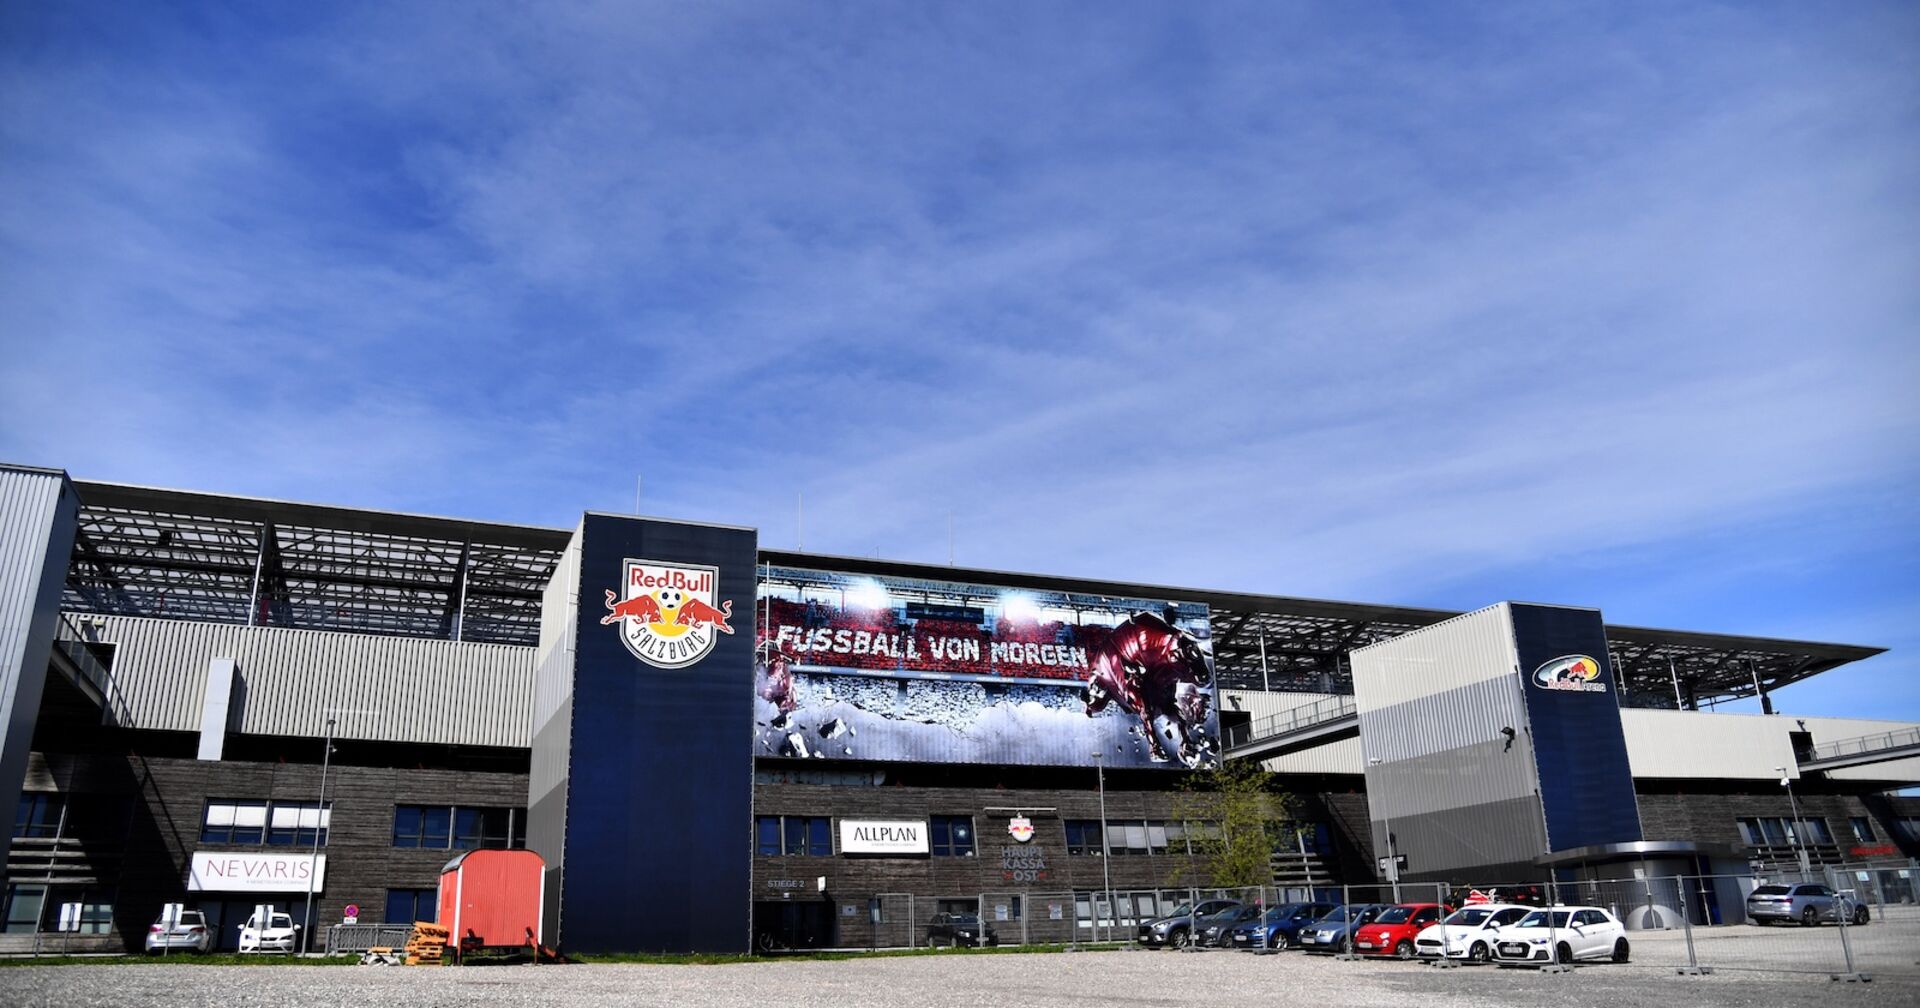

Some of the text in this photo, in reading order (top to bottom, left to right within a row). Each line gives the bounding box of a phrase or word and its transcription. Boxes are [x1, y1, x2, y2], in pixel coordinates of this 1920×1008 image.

[631, 568, 710, 592] Red Bull
[630, 626, 706, 660] SALZBURG
[774, 625, 1088, 668] FUSSBALL VON MORGEN
[854, 826, 917, 841] ALLPLAN
[1001, 845, 1044, 857] HAUPT
[206, 859, 310, 879] NEVARIS
[1002, 858, 1046, 870] KASSA
[1013, 869, 1038, 881] OST
[767, 880, 805, 888] STIEGE 2
